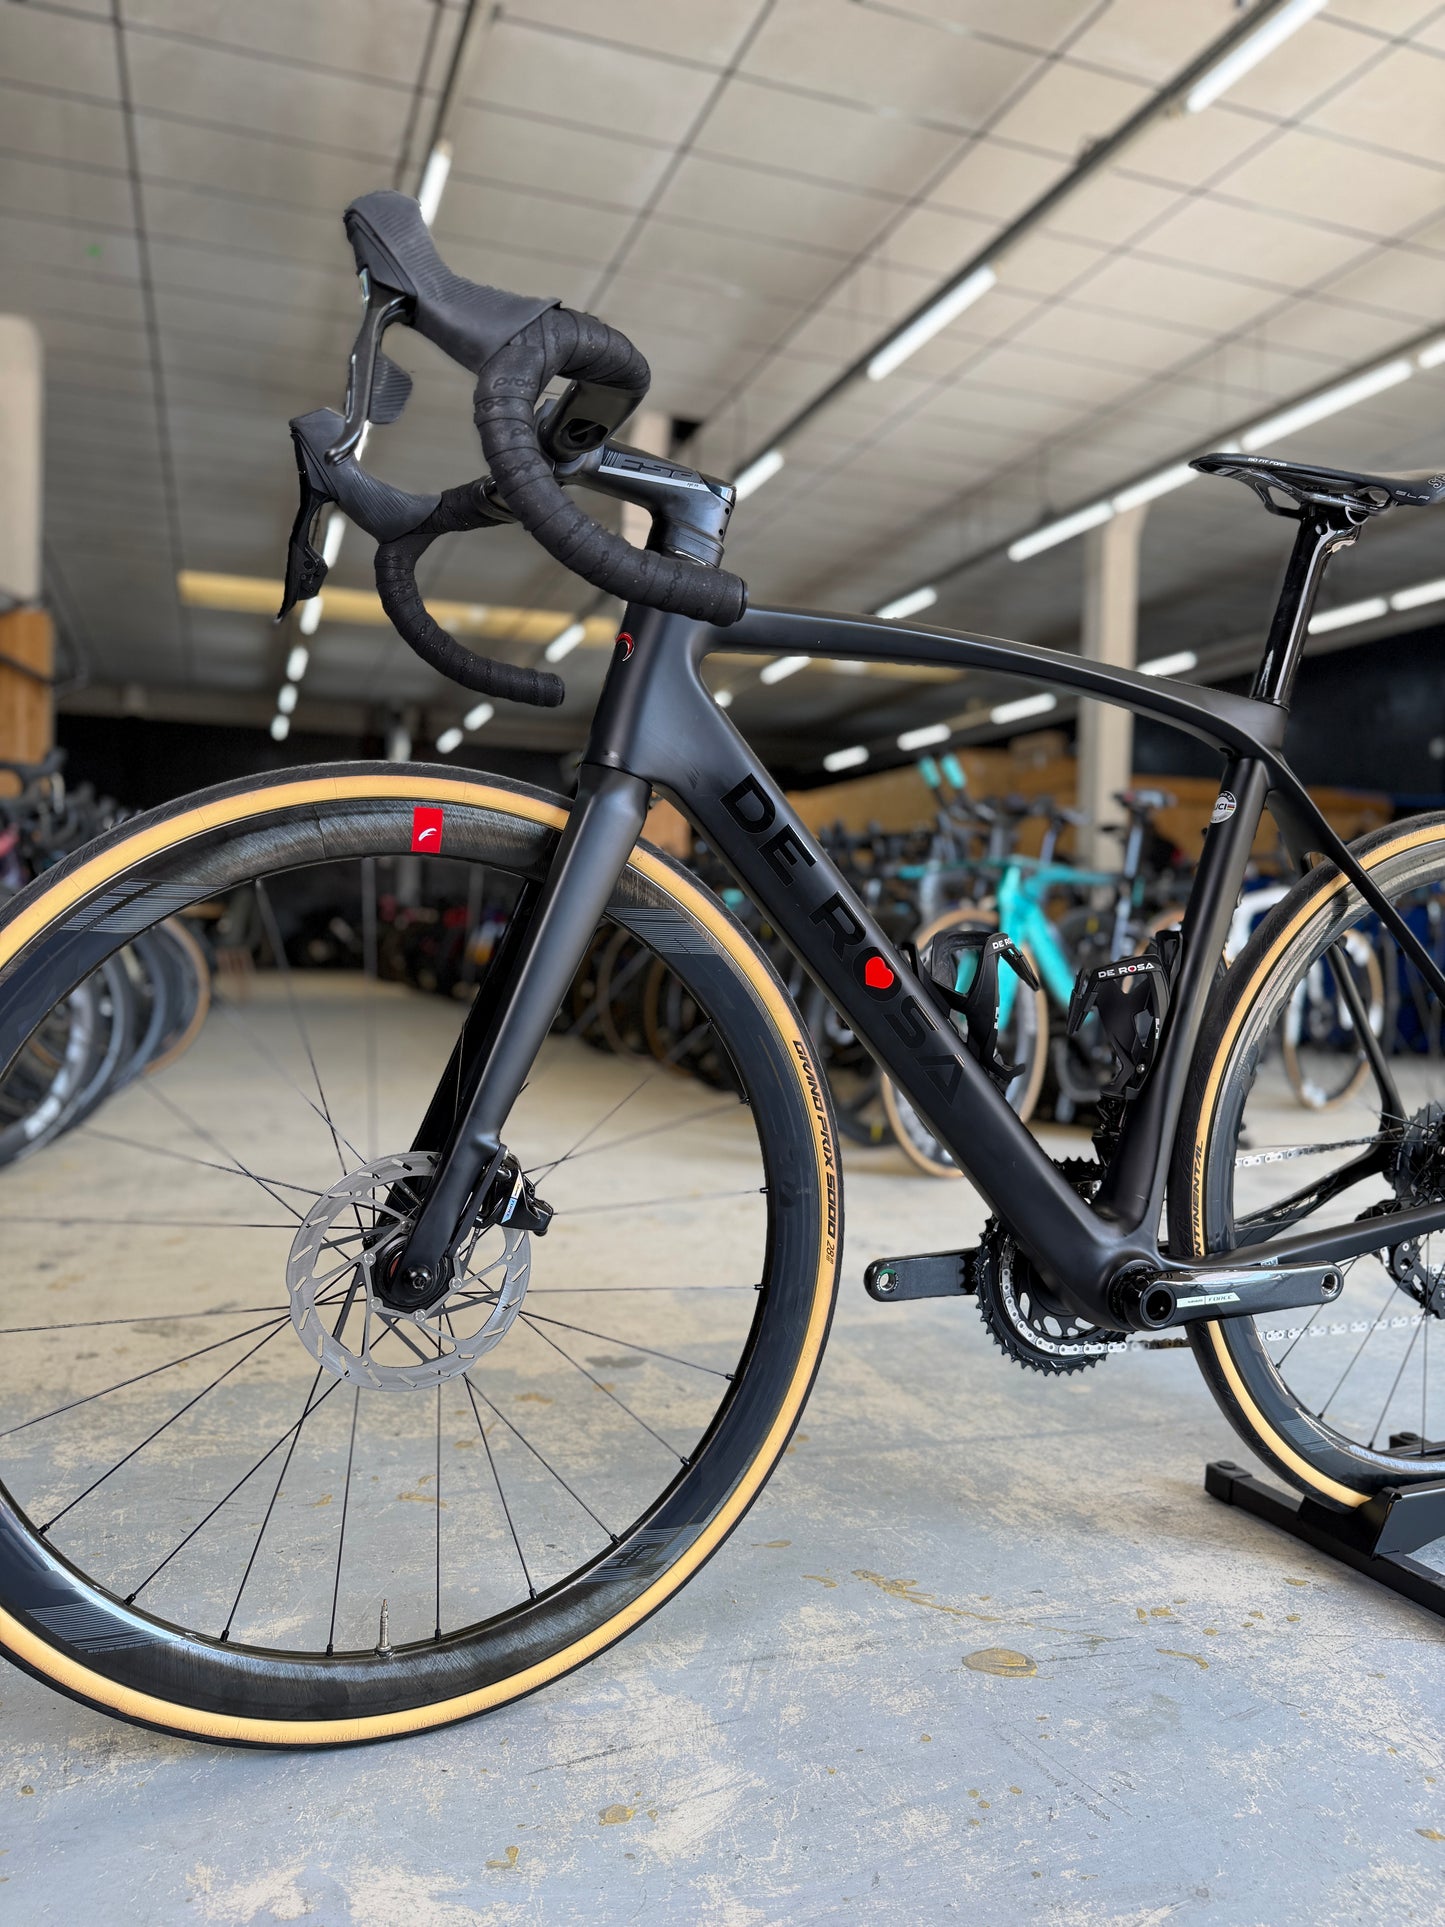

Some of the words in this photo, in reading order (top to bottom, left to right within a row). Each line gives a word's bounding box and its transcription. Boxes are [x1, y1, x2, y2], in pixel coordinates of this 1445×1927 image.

[719, 773, 818, 888] DE
[809, 890, 966, 1106] ROSA
[992, 940, 1005, 950] DE
[1098, 969, 1115, 979] DE
[1118, 962, 1155, 975] ROSA
[793, 1040, 825, 1113] GRAND
[816, 1115, 835, 1171] PRIX
[826, 1171, 839, 1240] 5000
[1192, 1140, 1204, 1258] NTINENTAL
